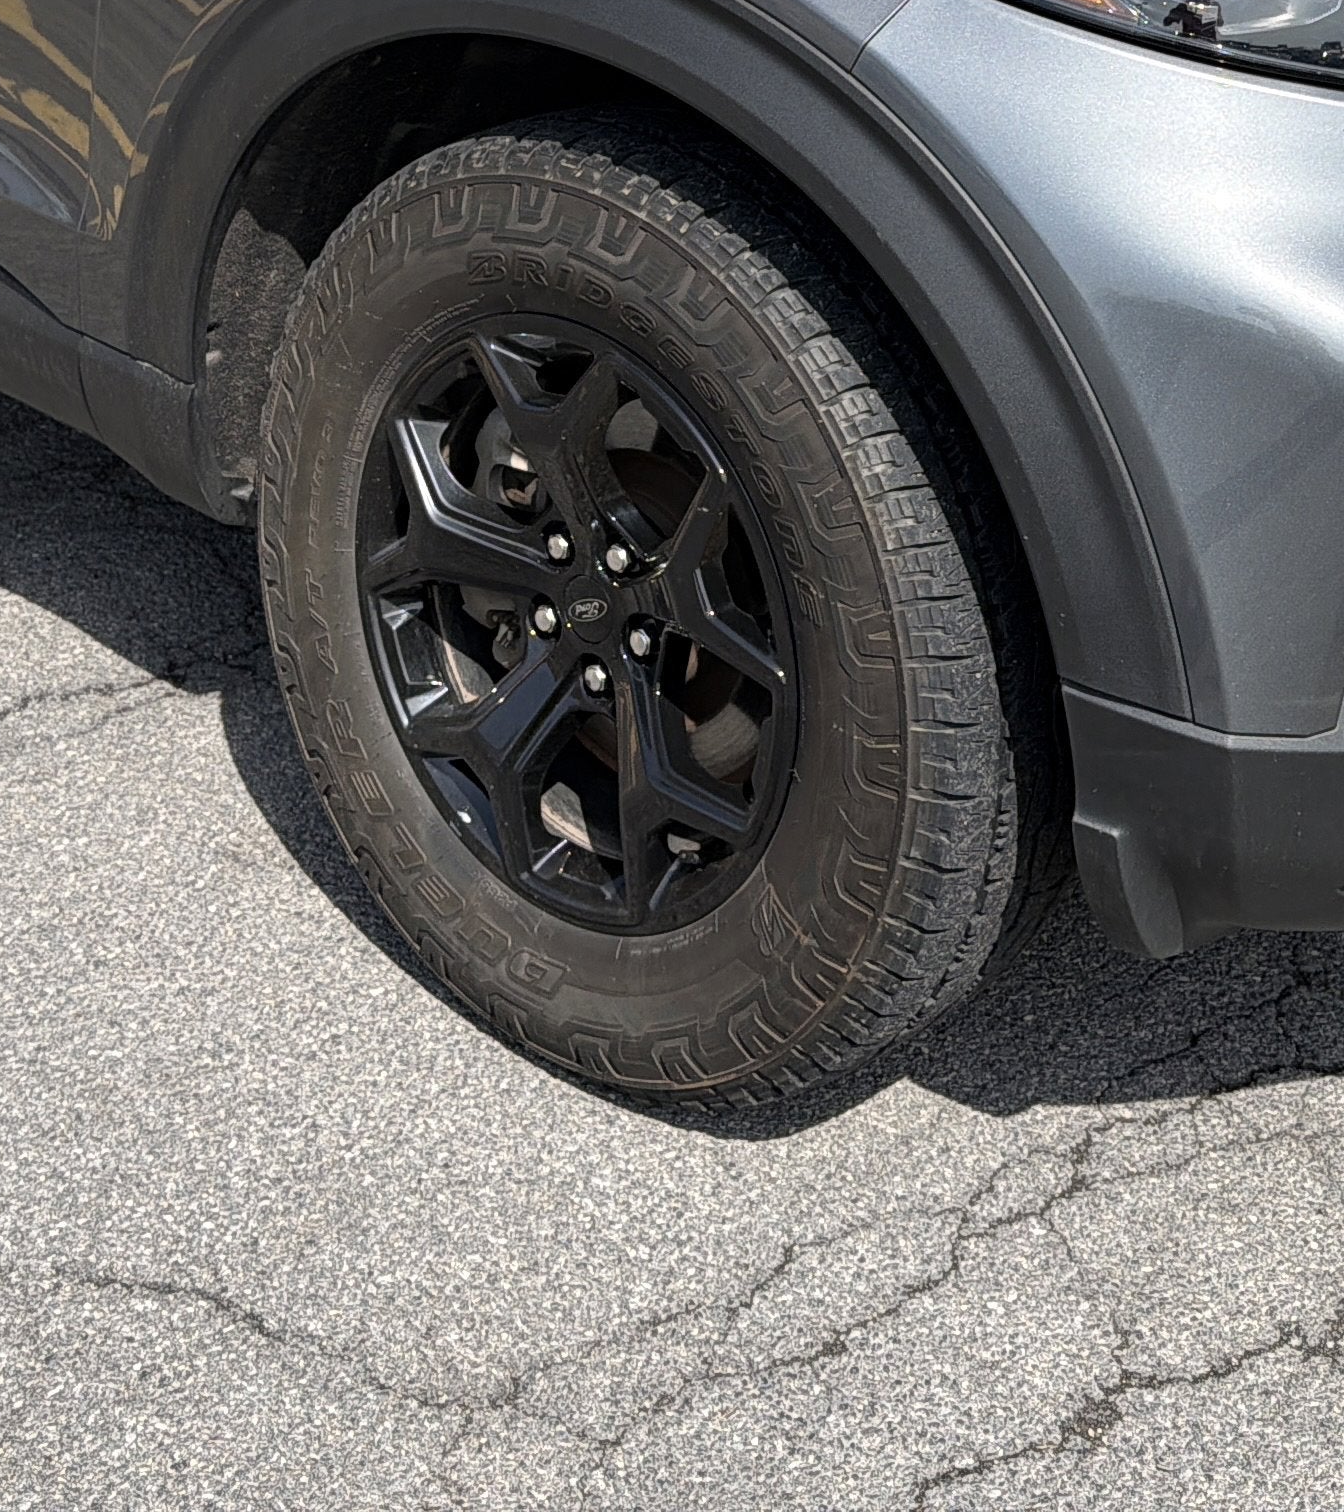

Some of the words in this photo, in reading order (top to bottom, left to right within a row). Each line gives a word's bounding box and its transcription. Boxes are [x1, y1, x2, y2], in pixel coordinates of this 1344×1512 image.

[466, 248, 825, 628] BRIDGESTONE
[304, 567, 339, 675] A/T
[326, 697, 572, 997] DUELER
